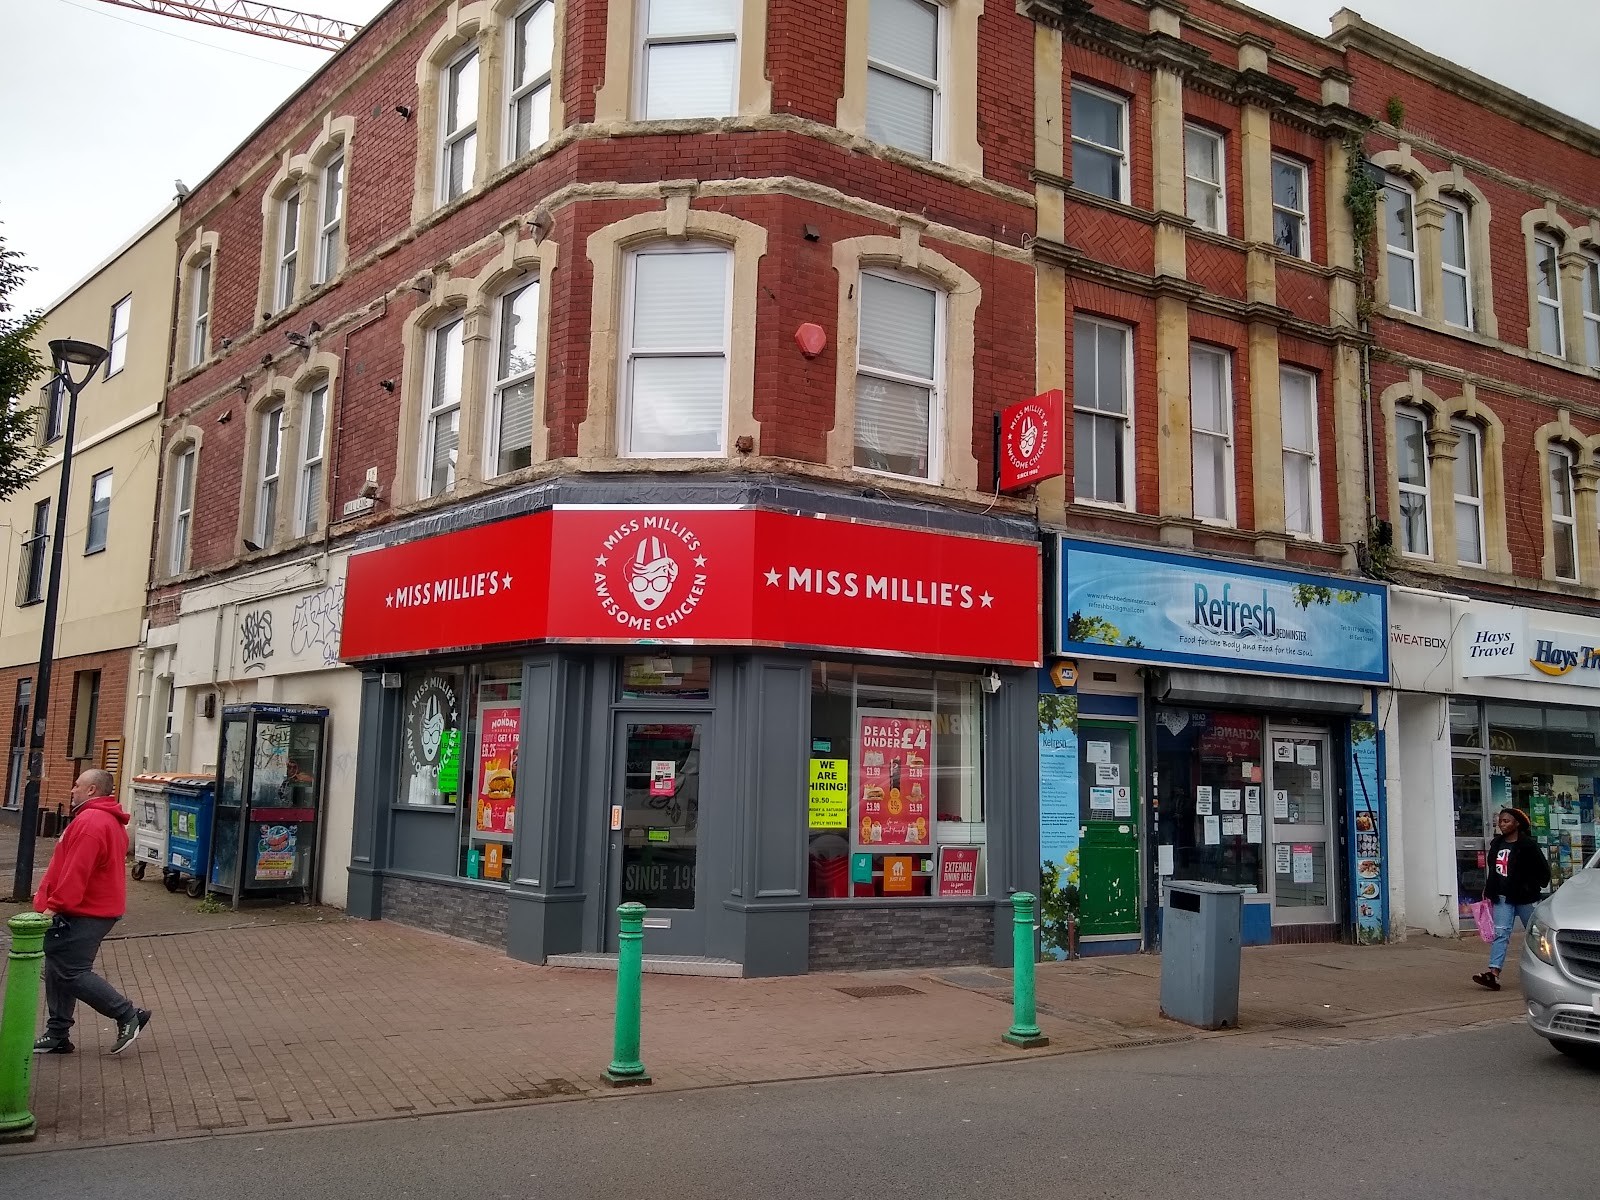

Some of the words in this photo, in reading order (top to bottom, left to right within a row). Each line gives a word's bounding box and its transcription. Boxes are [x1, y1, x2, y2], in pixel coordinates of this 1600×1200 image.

[1010, 409, 1024, 430] MISS
[1007, 443, 1028, 469] AWESOME
[1029, 430, 1048, 466] CHICKEN
[603, 519, 640, 551] MISS
[643, 516, 701, 551] MILLIE'S
[395, 582, 431, 609] MISS
[433, 570, 499, 603] MILLIE'S
[788, 566, 858, 598] MISS
[865, 574, 974, 609] MILLIE'S
[594, 572, 652, 631] AWESOME
[655, 573, 707, 630] CHICKEN
[1194, 582, 1276, 636] Refresh
[1276, 628, 1307, 642] BEDMINSTER
[1475, 630, 1511, 645] Hays
[1179, 635, 1196, 644] Food
[1197, 636, 1209, 648] for
[1210, 638, 1221, 647] the
[1222, 640, 1241, 653] Body
[1257, 644, 1273, 652] Food
[1275, 644, 1285, 656] for
[1285, 647, 1296, 656] the
[1297, 648, 1313, 657] Soul
[1470, 642, 1515, 658] Travel
[1535, 639, 1579, 672] Hays
[1580, 645, 1600, 670] Tr
[411, 680, 429, 709] MISS
[429, 677, 456, 707] MILLIE'S
[263, 705, 281, 713] e-mail
[491, 718, 518, 729] MONDAY
[864, 725, 900, 737] DEALS
[497, 733, 508, 743] GET
[863, 737, 900, 748] UNDER
[901, 728, 927, 750] £4
[406, 728, 431, 778] AWESOME
[432, 727, 458, 778] CHICKEN
[819, 760, 835, 769] WE
[817, 771, 838, 780] ARE
[809, 782, 847, 791] HIRING!
[944, 861, 973, 873] EXTERNAL
[960, 872, 973, 882] AREA
[625, 865, 669, 891] SINCE
